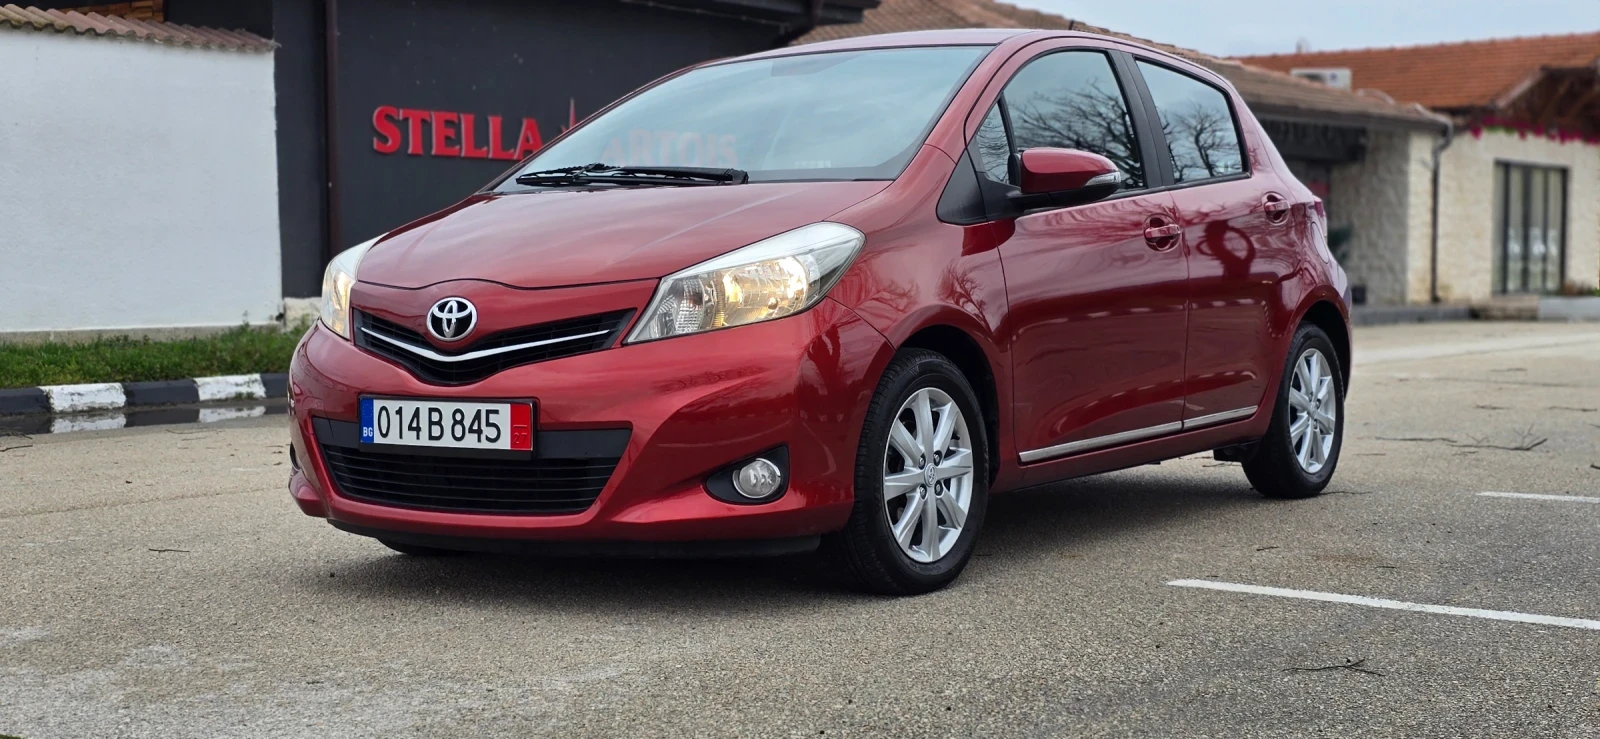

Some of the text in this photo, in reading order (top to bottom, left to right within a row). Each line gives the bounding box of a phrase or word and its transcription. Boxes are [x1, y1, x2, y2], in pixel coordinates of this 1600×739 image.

[372, 106, 738, 167] STELLA ARTOIS
[362, 427, 373, 437] BG
